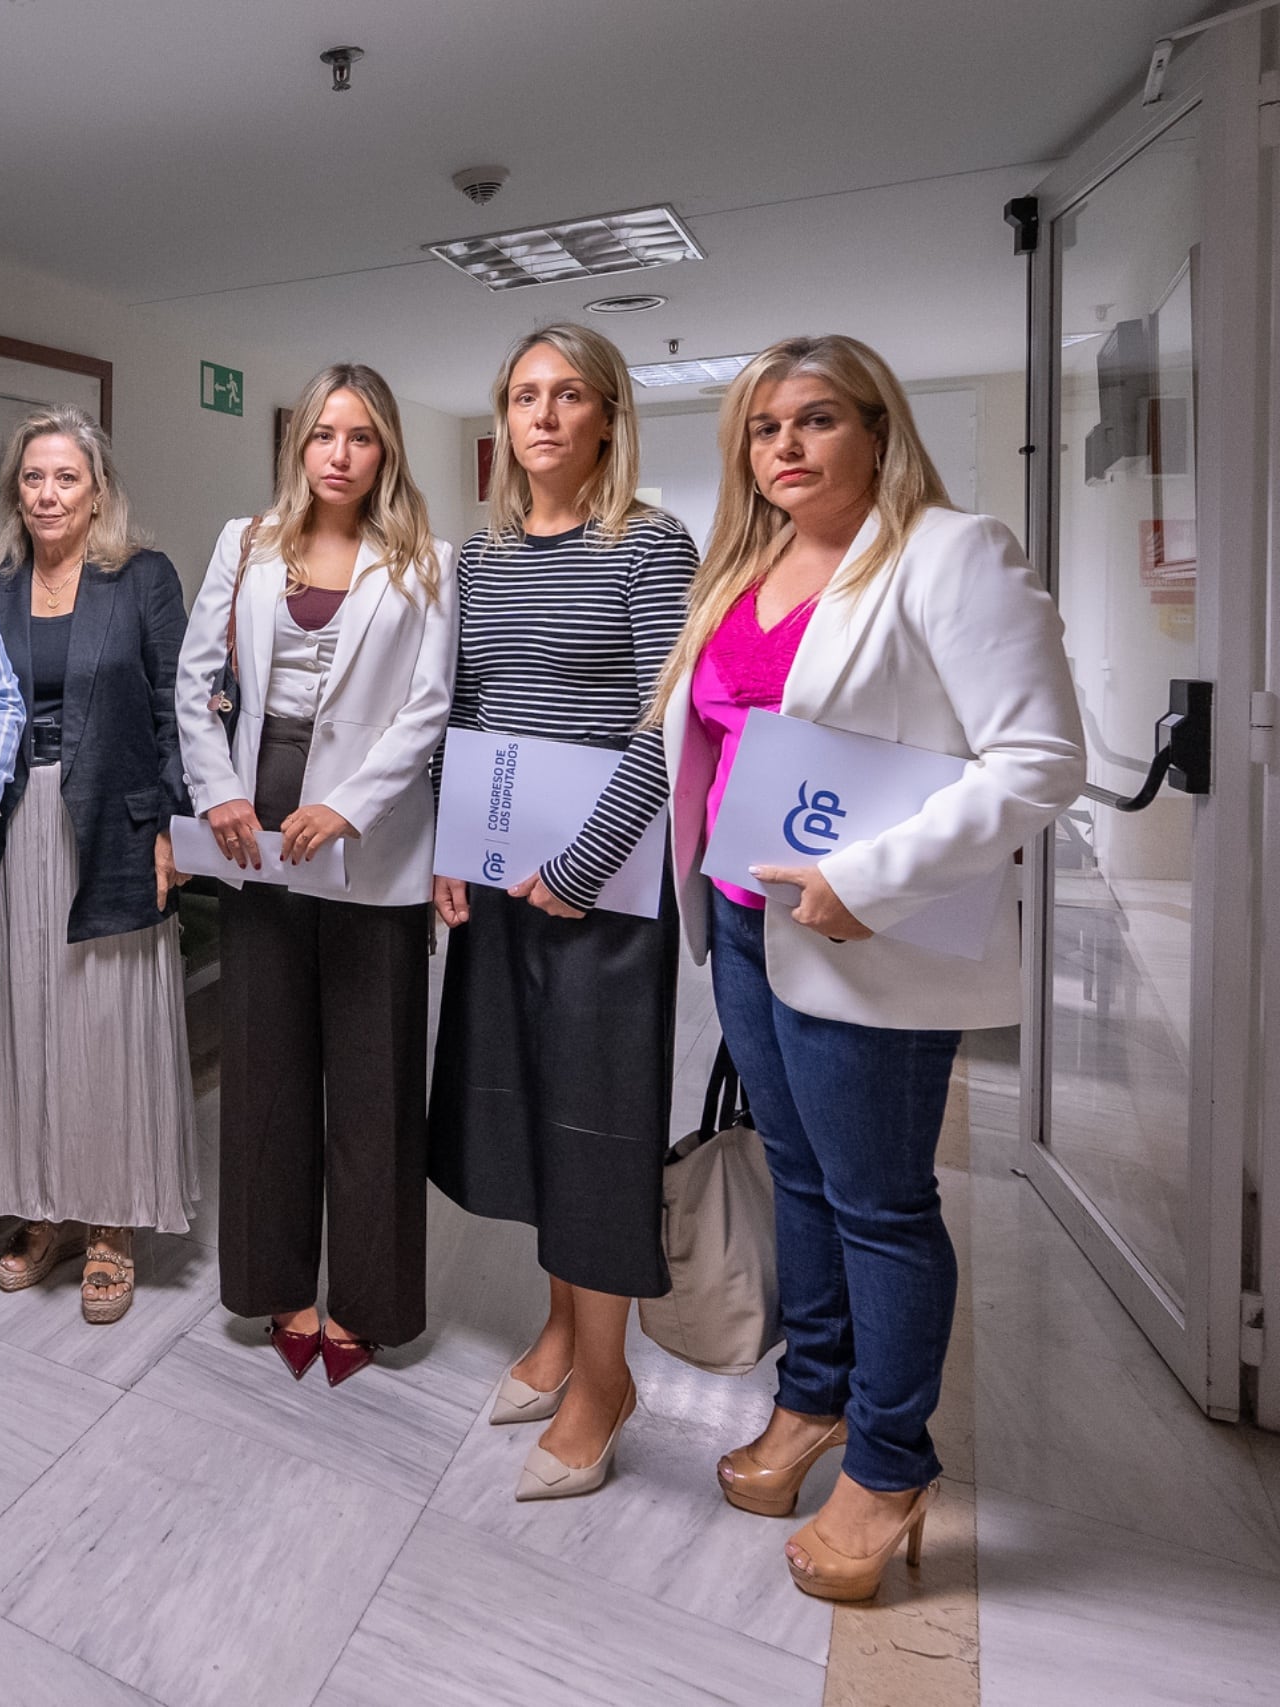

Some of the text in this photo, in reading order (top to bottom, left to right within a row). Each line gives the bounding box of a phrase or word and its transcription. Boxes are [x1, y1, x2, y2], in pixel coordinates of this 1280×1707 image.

[488, 749, 506, 831] CONGRESO DE
[499, 742, 519, 833] LOS DIPUTADOS
